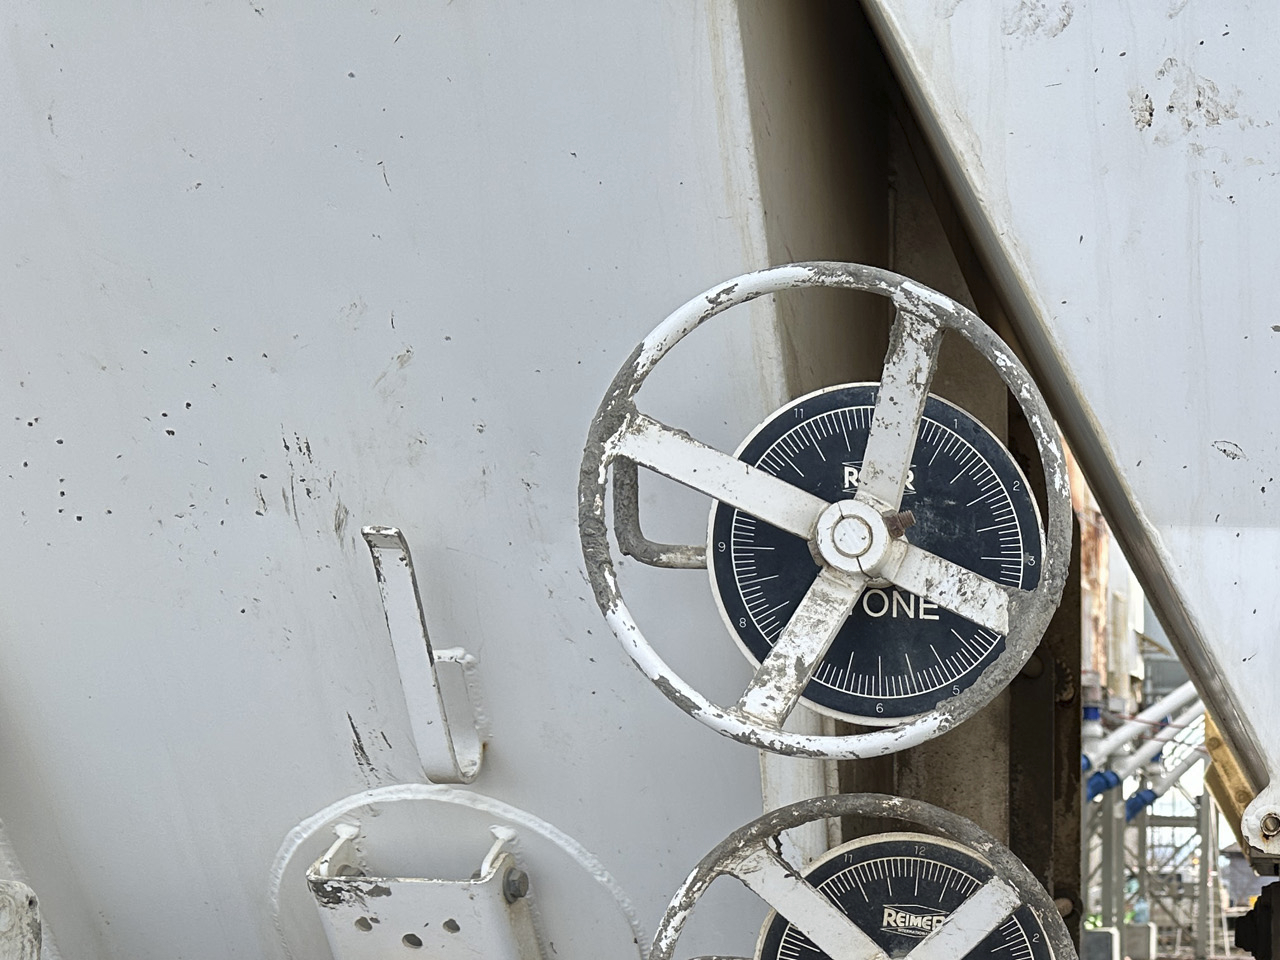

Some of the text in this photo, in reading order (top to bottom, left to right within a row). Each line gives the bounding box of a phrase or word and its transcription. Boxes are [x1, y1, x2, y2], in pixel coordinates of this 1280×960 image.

[793, 407, 804, 419] 11
[1012, 481, 1021, 492] 2
[717, 542, 726, 553] 9
[1027, 556, 1036, 567] 3
[849, 588, 940, 620] ONE
[738, 617, 747, 628] 8
[952, 684, 960, 696] 5
[875, 703, 884, 714] 6
[914, 846, 926, 856] 12
[843, 854, 853, 863] 11
[1032, 933, 1040, 943] 2
